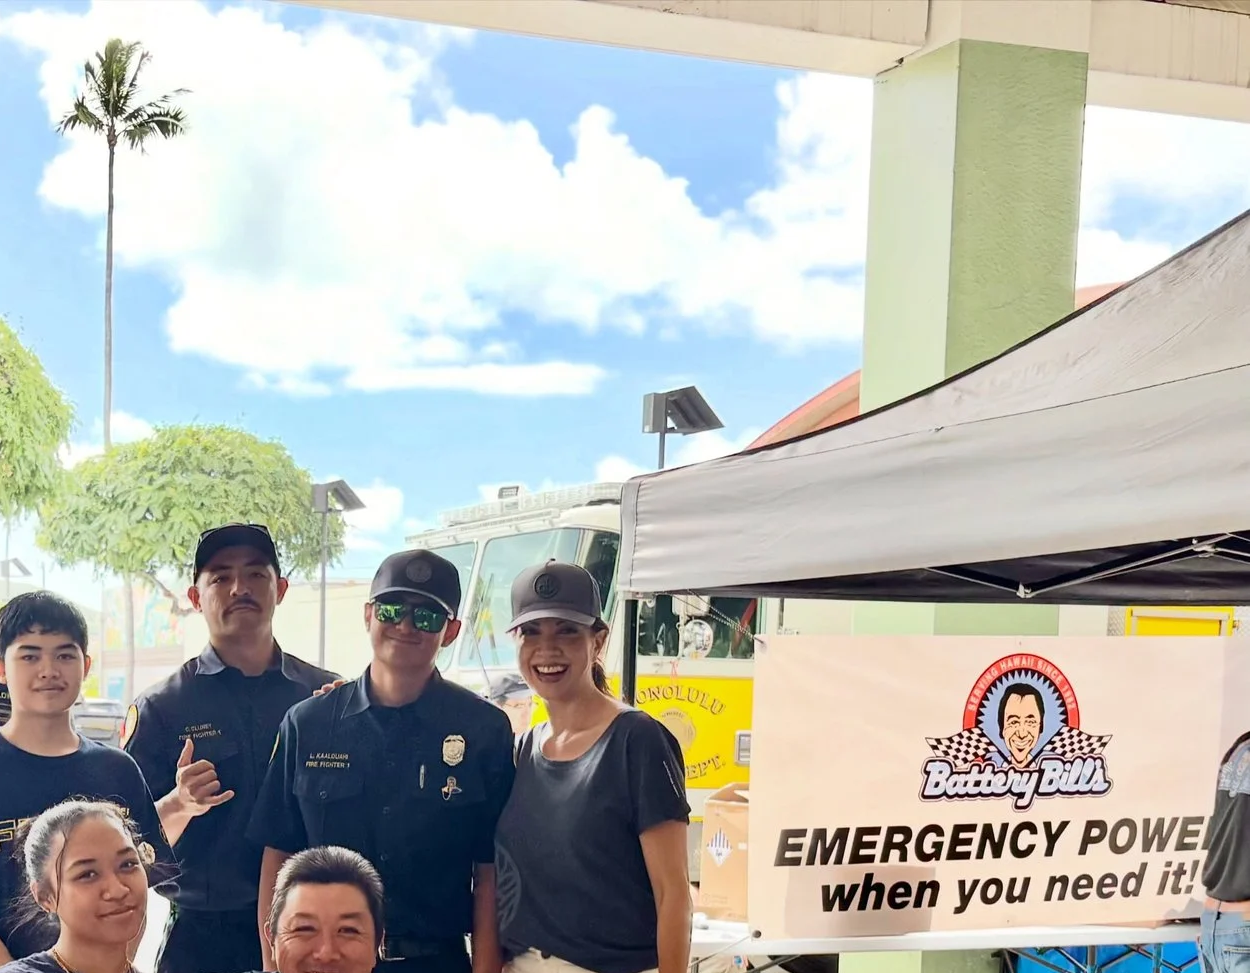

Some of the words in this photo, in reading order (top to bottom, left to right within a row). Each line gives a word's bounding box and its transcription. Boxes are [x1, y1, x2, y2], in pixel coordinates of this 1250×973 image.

[636, 684, 727, 716] ONOLULU
[923, 761, 1038, 807] Battery
[774, 820, 1070, 867] EMERGENCY
[821, 872, 940, 912] when
[953, 875, 1031, 915] you
[1044, 862, 1148, 902] need
[1156, 859, 1200, 896] it!
